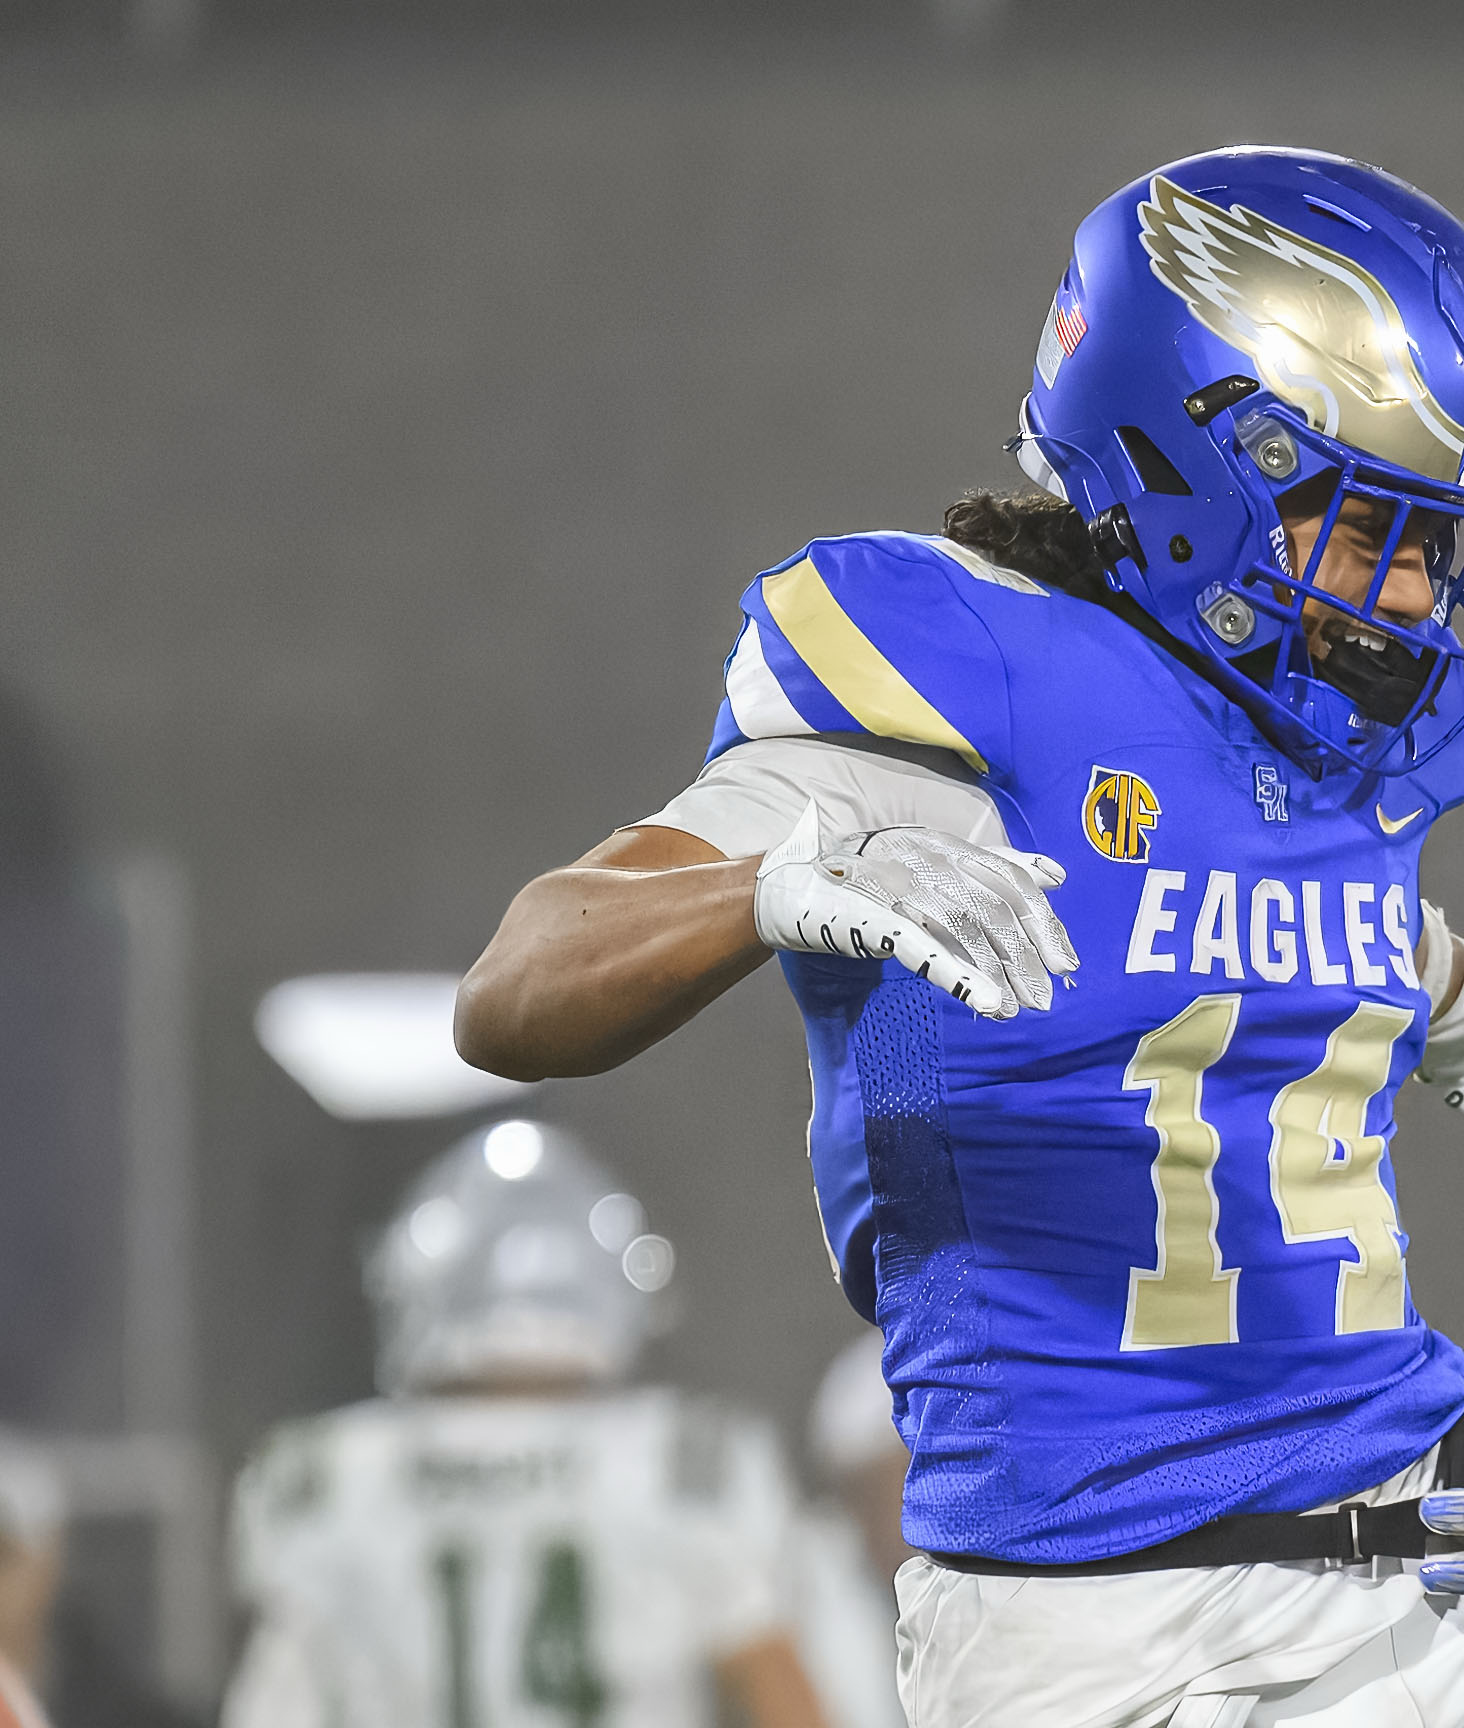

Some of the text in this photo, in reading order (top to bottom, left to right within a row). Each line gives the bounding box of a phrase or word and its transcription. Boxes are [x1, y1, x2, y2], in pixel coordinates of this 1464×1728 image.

[1084, 774, 1159, 859] CIF
[1125, 868, 1422, 990] EAGLES
[1119, 992, 1415, 1352] 14
